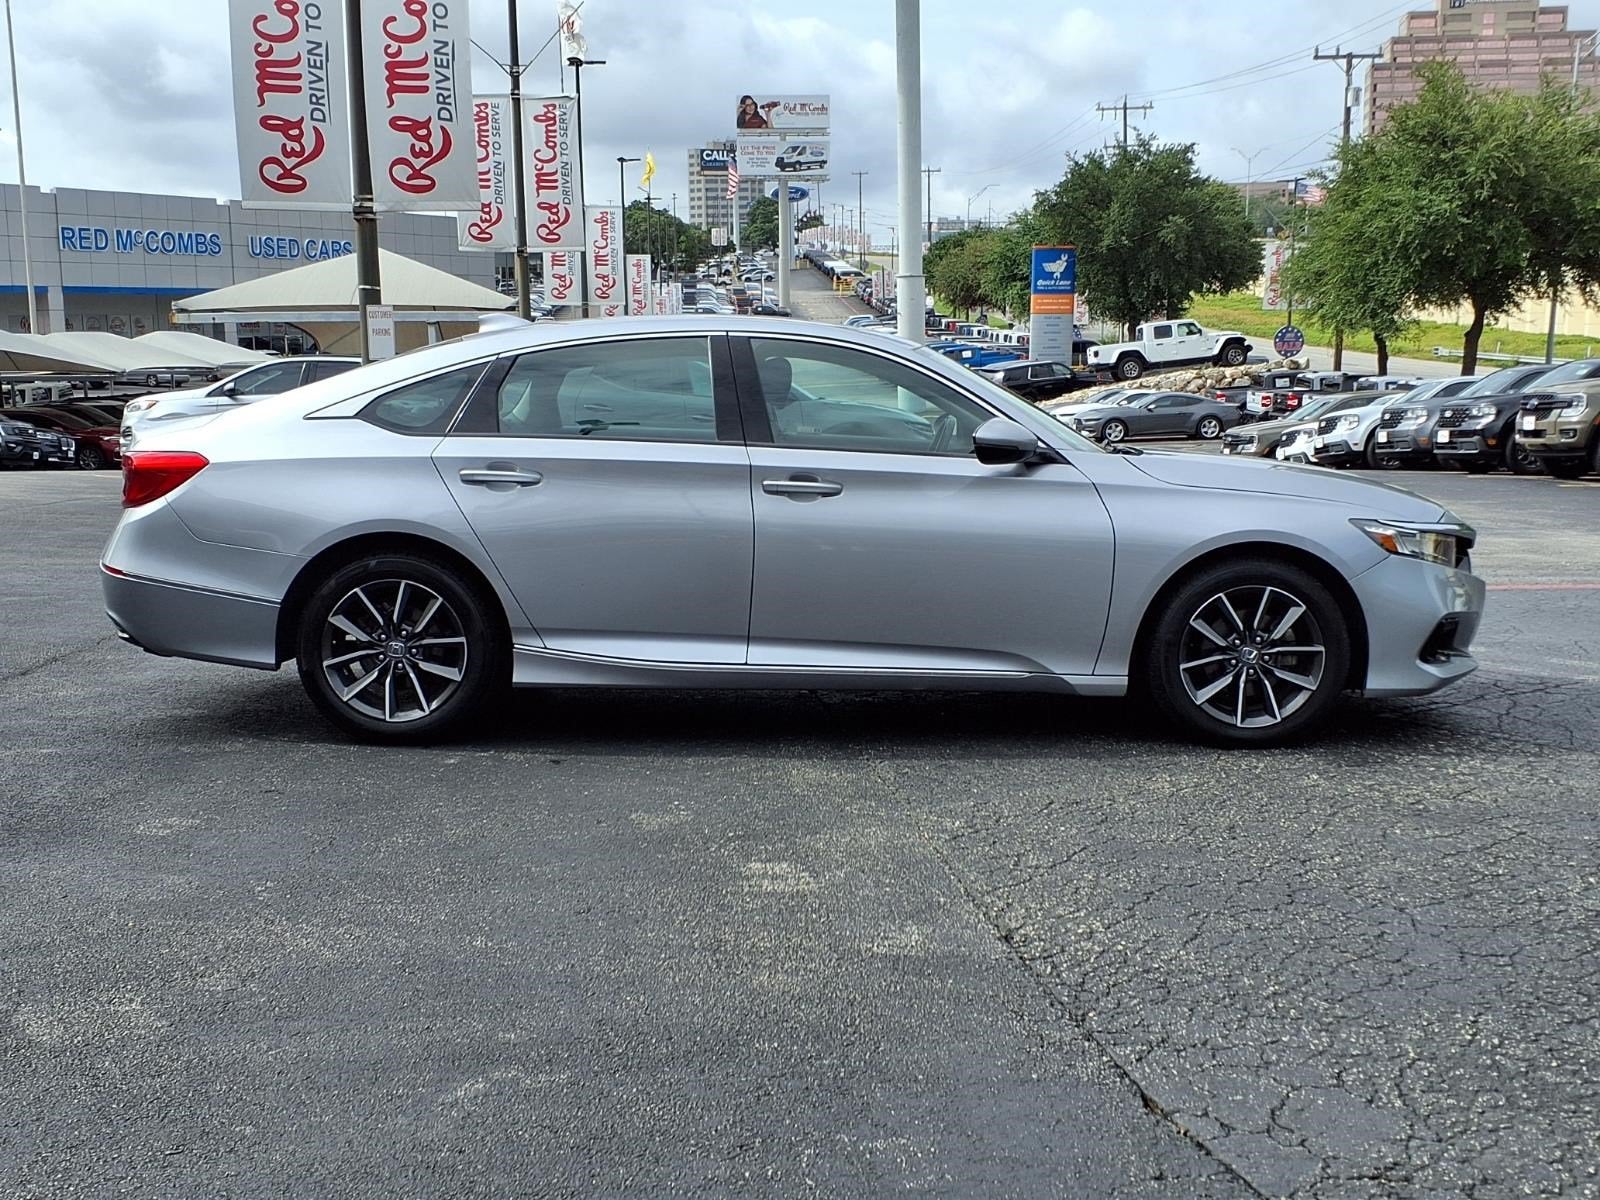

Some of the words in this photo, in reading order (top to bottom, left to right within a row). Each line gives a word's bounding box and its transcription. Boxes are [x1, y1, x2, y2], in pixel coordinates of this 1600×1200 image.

[304, 2, 322, 33] TO
[432, 2, 449, 32] TO
[252, 0, 303, 108] McCo
[382, 0, 430, 108] McCo
[306, 39, 327, 124] DRIVEN
[433, 39, 454, 123] DRIVEN
[490, 102, 501, 139] SERVE
[558, 103, 569, 140] SERVE
[783, 102, 797, 115] Red
[798, 102, 828, 112] McCombs
[258, 114, 325, 194] Red
[388, 115, 453, 194] Red
[492, 141, 502, 159] TO
[533, 103, 559, 198] McCombs
[559, 141, 569, 159] TO
[493, 160, 504, 205] DRIVEN
[560, 161, 572, 205] DRIVEN
[536, 201, 571, 243] Red
[59, 226, 109, 251] RED
[115, 229, 222, 255] McCOMBS
[249, 236, 300, 258] USED
[305, 239, 353, 260] CARS
[593, 211, 609, 270] McCombs
[609, 235, 616, 247] TO
[550, 273, 573, 300] Red
[594, 273, 617, 300] Red
[632, 258, 642, 298] McCombs
[368, 310, 392, 319] CUSTOMER
[632, 299, 647, 316] Red
[372, 327, 391, 336] PARKING
[1276, 341, 1302, 351] SALE
